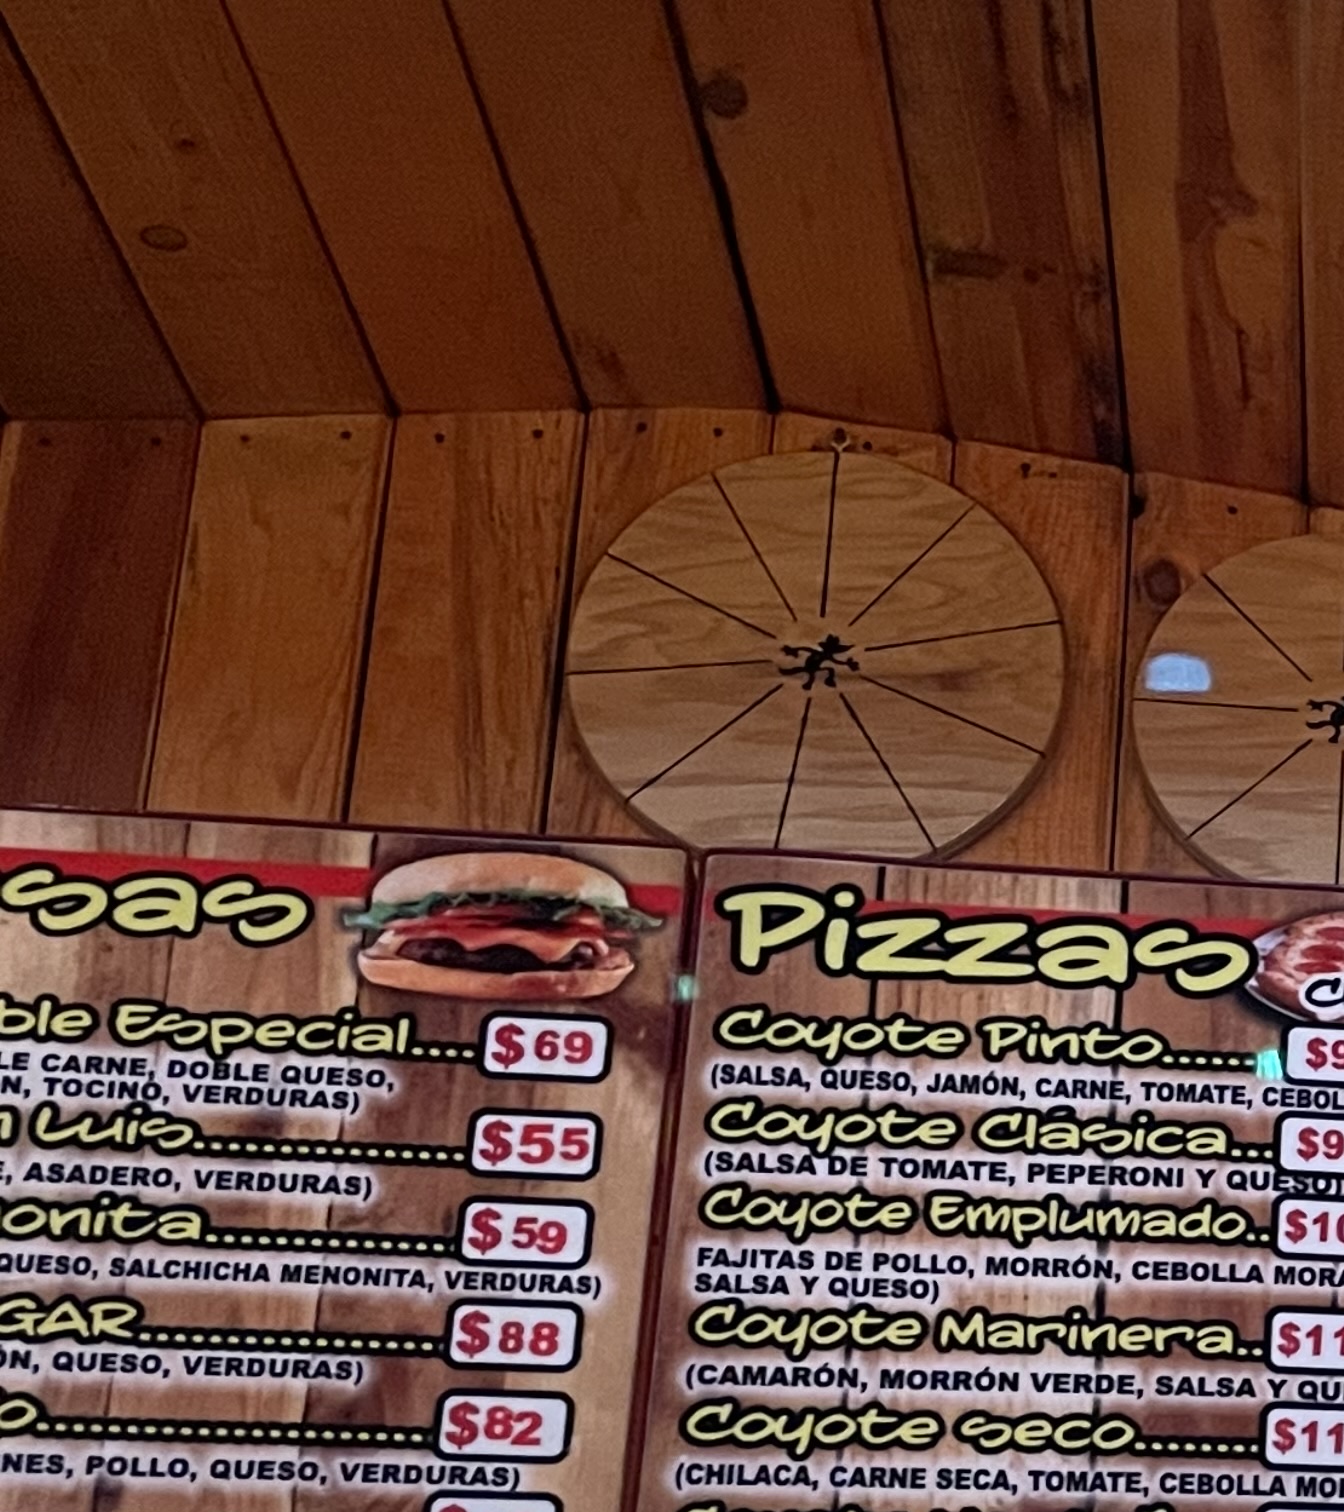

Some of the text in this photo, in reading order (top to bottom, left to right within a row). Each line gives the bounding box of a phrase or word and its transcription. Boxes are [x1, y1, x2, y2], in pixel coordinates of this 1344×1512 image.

[720, 888, 1252, 995] Pizzas
[493, 1023, 593, 1067] $69
[716, 1007, 967, 1060] Coyote
[711, 1063, 811, 1092] (SALSA,
[820, 1068, 917, 1097] QUESO,
[926, 1070, 1026, 1101] JAMÓN,
[1035, 1078, 1131, 1105] CARNE,
[1140, 1081, 1253, 1110] TOMATE,
[480, 1120, 590, 1165] $55
[708, 1100, 959, 1152] Coyote
[22, 1162, 372, 1202] ASADERO, VERDURAS)
[468, 1208, 568, 1255] $59
[458, 1311, 560, 1357] $88
[692, 1303, 924, 1355] Coyote
[685, 1362, 868, 1394] (CAMARÓN,
[879, 1366, 1020, 1392] MORRÓN
[1030, 1372, 1144, 1400] VERDE,
[1154, 1375, 1257, 1398] SALSA
[1267, 1378, 1288, 1399] Y
[446, 1402, 542, 1448] $82
